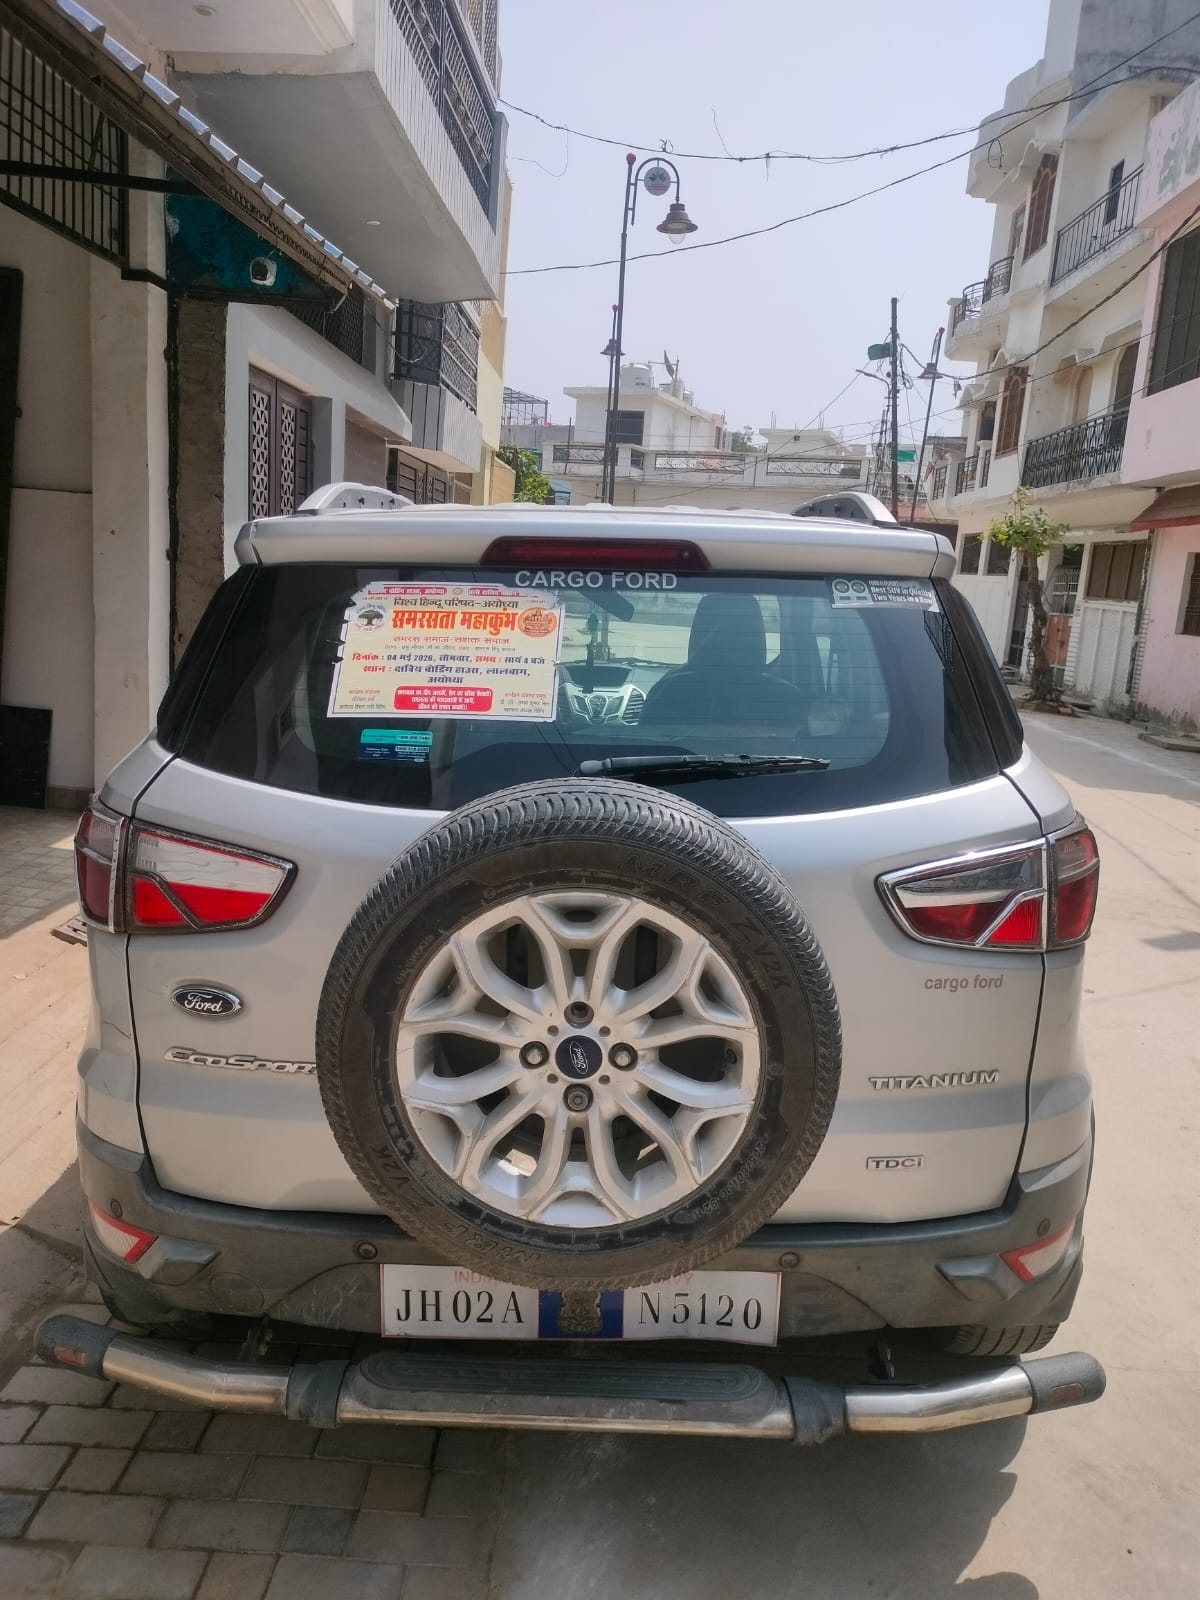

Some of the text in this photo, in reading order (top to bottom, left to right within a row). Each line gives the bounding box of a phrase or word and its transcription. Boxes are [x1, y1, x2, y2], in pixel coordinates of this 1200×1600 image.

[515, 570, 678, 589] CARGO FORD
[870, 586, 932, 598] Best SUV in Quality
[888, 594, 906, 602] Years
[393, 597, 417, 607] विश्व
[419, 597, 444, 609] हिन्दू
[391, 608, 518, 636] समरसता महाकुंभ
[484, 637, 510, 645] समाज
[352, 652, 379, 661] दिनांक
[399, 652, 411, 662] मई
[413, 654, 436, 662] 2026,
[439, 653, 473, 663] सोमवार,
[475, 655, 497, 663] समय
[530, 655, 545, 665] बजे
[363, 665, 386, 673] स्थान
[394, 665, 422, 674] क्षत्रिय
[424, 665, 453, 674] बोर्डिंग
[454, 667, 482, 676] हाउस,
[486, 667, 531, 676] लालबाग,
[427, 676, 463, 684] अयोध्या
[924, 974, 1004, 992] cargo ford
[184, 992, 223, 1013] Ford
[572, 1047, 586, 1069] Ford
[868, 1069, 1000, 1091] TITANIUM
[870, 1157, 922, 1169] TDCi
